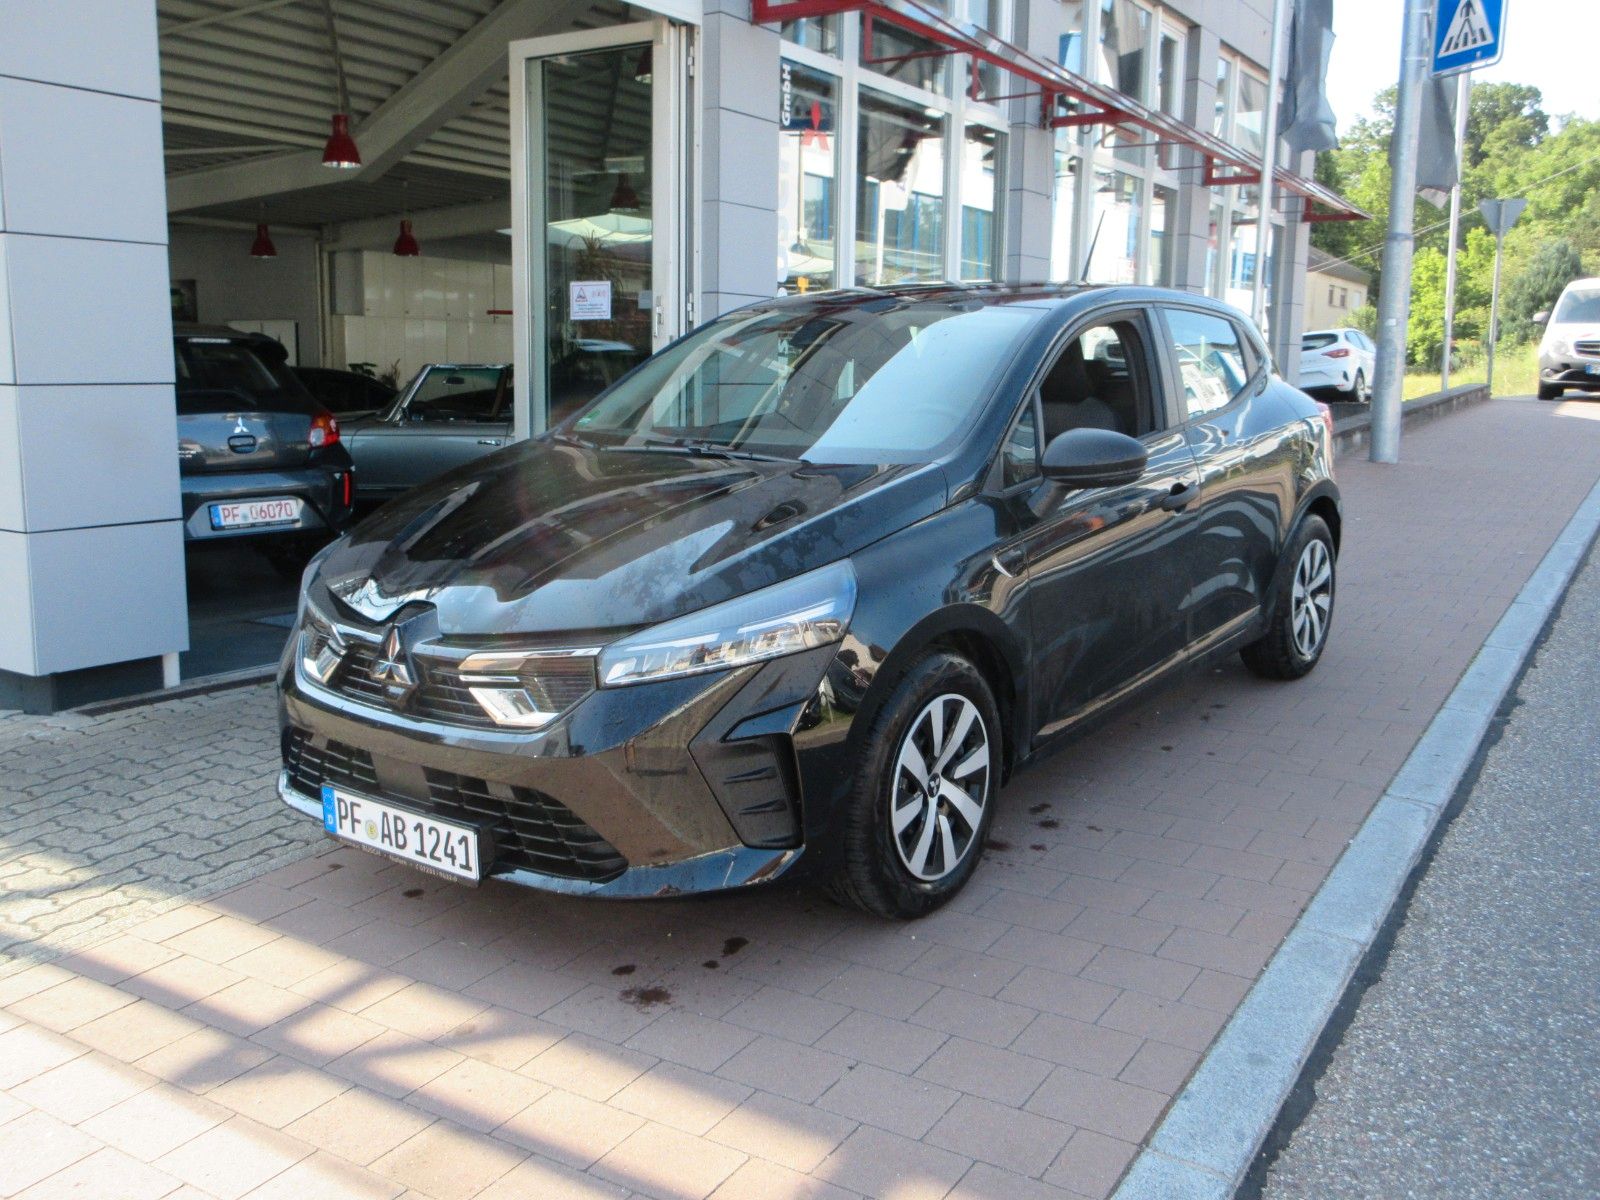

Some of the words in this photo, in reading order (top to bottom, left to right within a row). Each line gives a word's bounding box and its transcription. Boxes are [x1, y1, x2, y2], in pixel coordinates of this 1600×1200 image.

[782, 64, 791, 126] GmbH
[222, 507, 239, 521] PF
[250, 502, 293, 520] 06070
[337, 797, 361, 833] PF
[381, 811, 408, 850] AB
[413, 822, 473, 872] 1241
